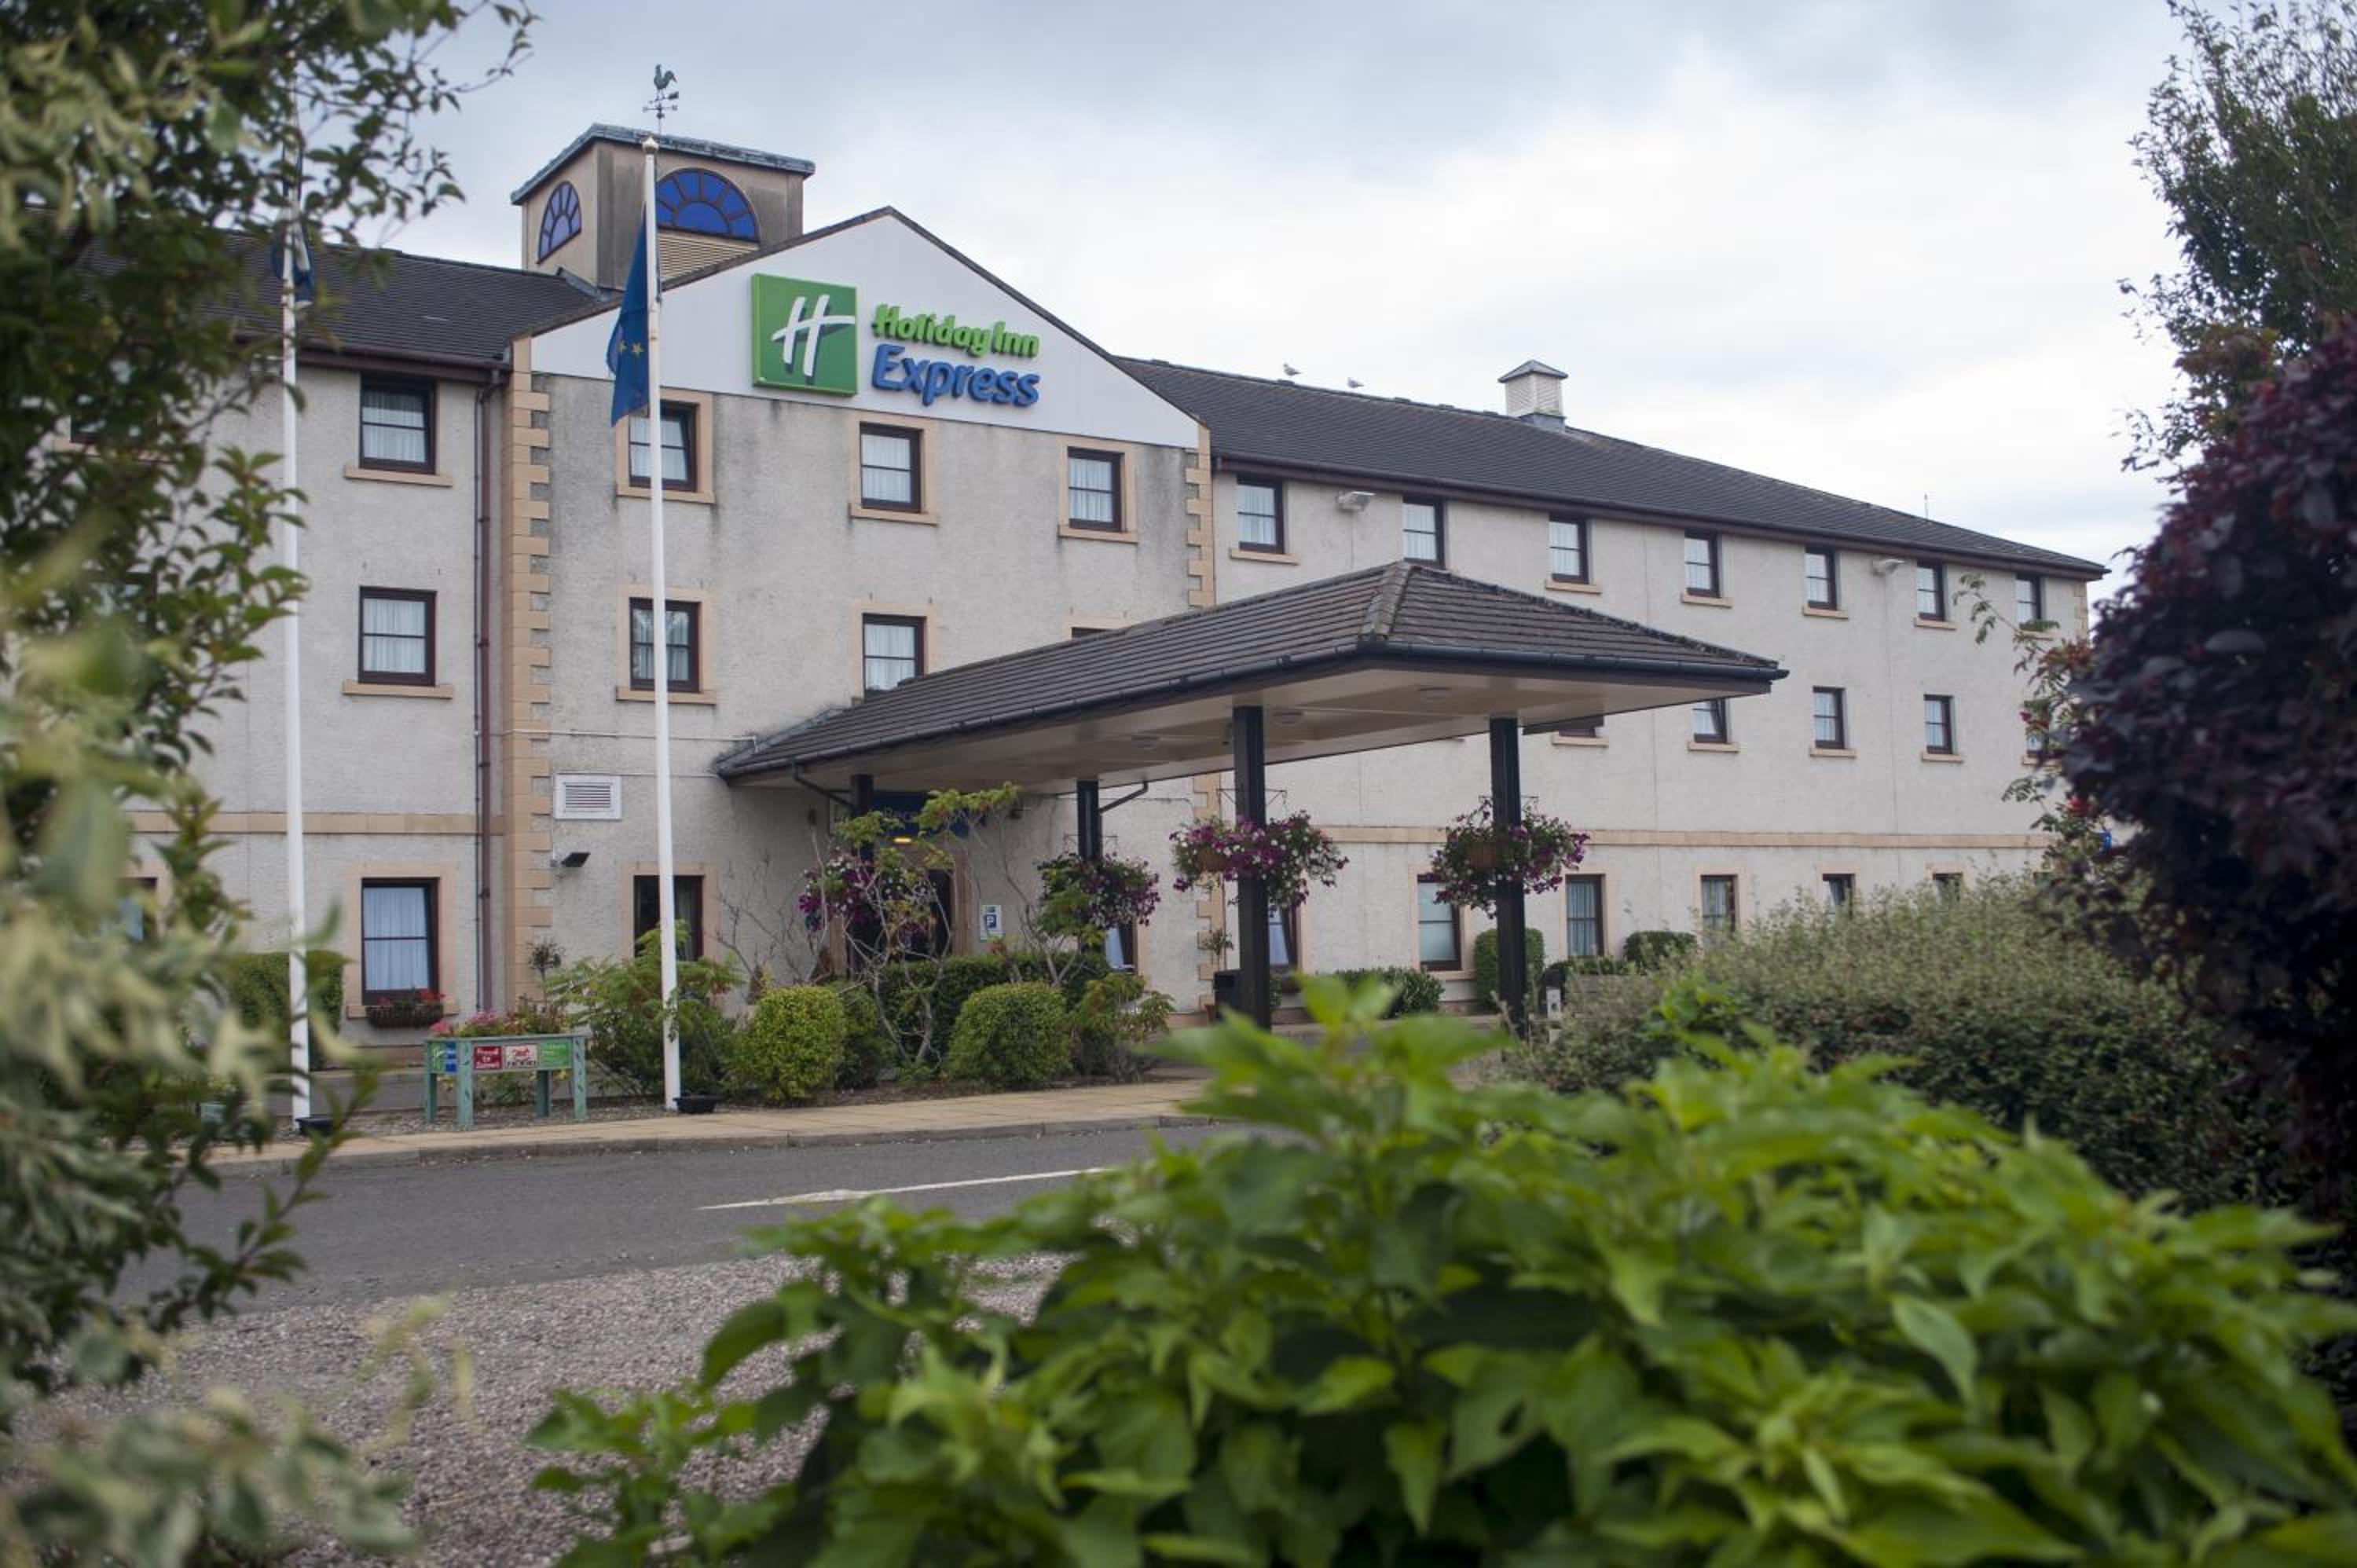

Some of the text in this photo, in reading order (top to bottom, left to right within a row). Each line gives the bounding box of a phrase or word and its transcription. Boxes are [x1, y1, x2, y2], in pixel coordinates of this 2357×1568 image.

[871, 303, 1040, 357] Holiday Inn
[871, 343, 1041, 407] Express
